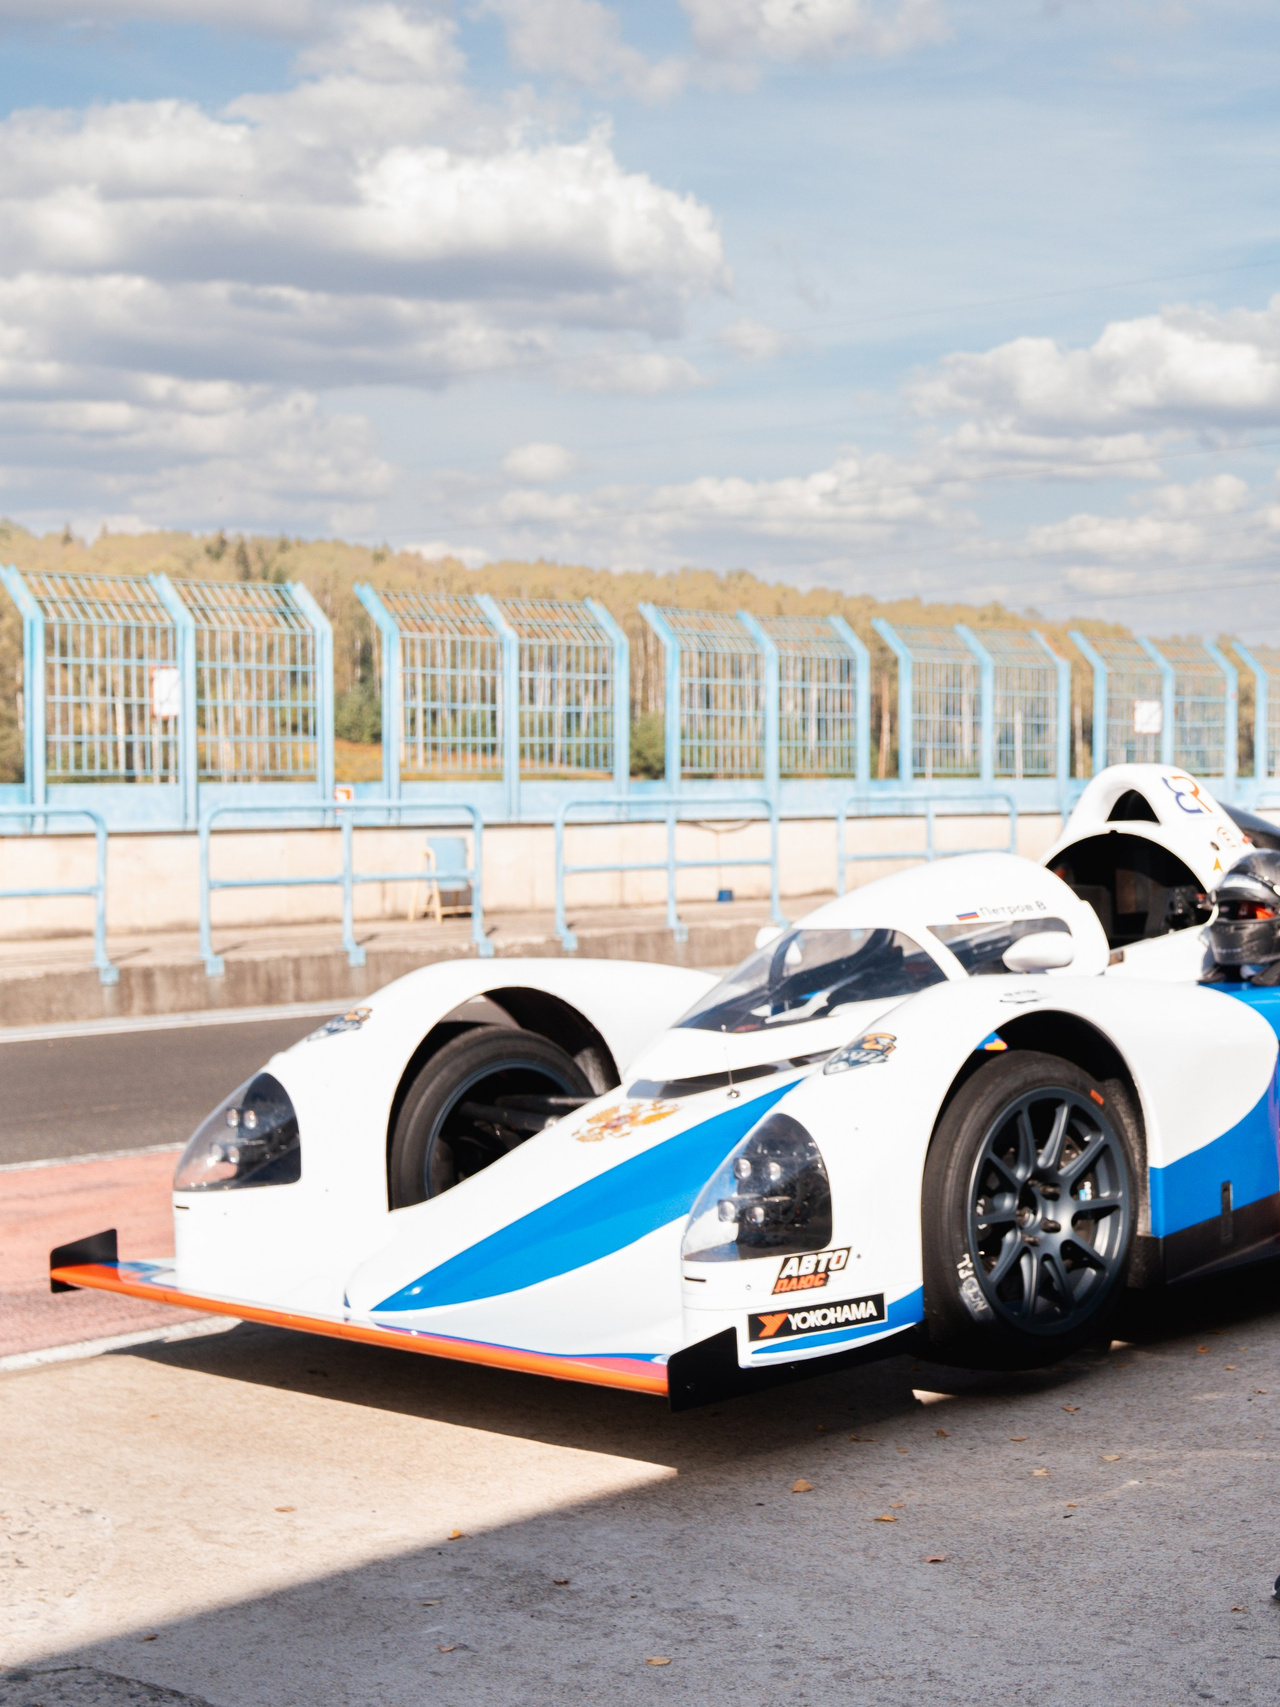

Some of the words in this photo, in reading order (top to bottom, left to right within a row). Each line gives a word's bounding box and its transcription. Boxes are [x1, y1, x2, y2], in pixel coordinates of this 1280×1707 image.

[779, 1249, 849, 1279] АВТО
[774, 1272, 827, 1293] ПЛЮС
[787, 1300, 878, 1331] YOKOHAMA
